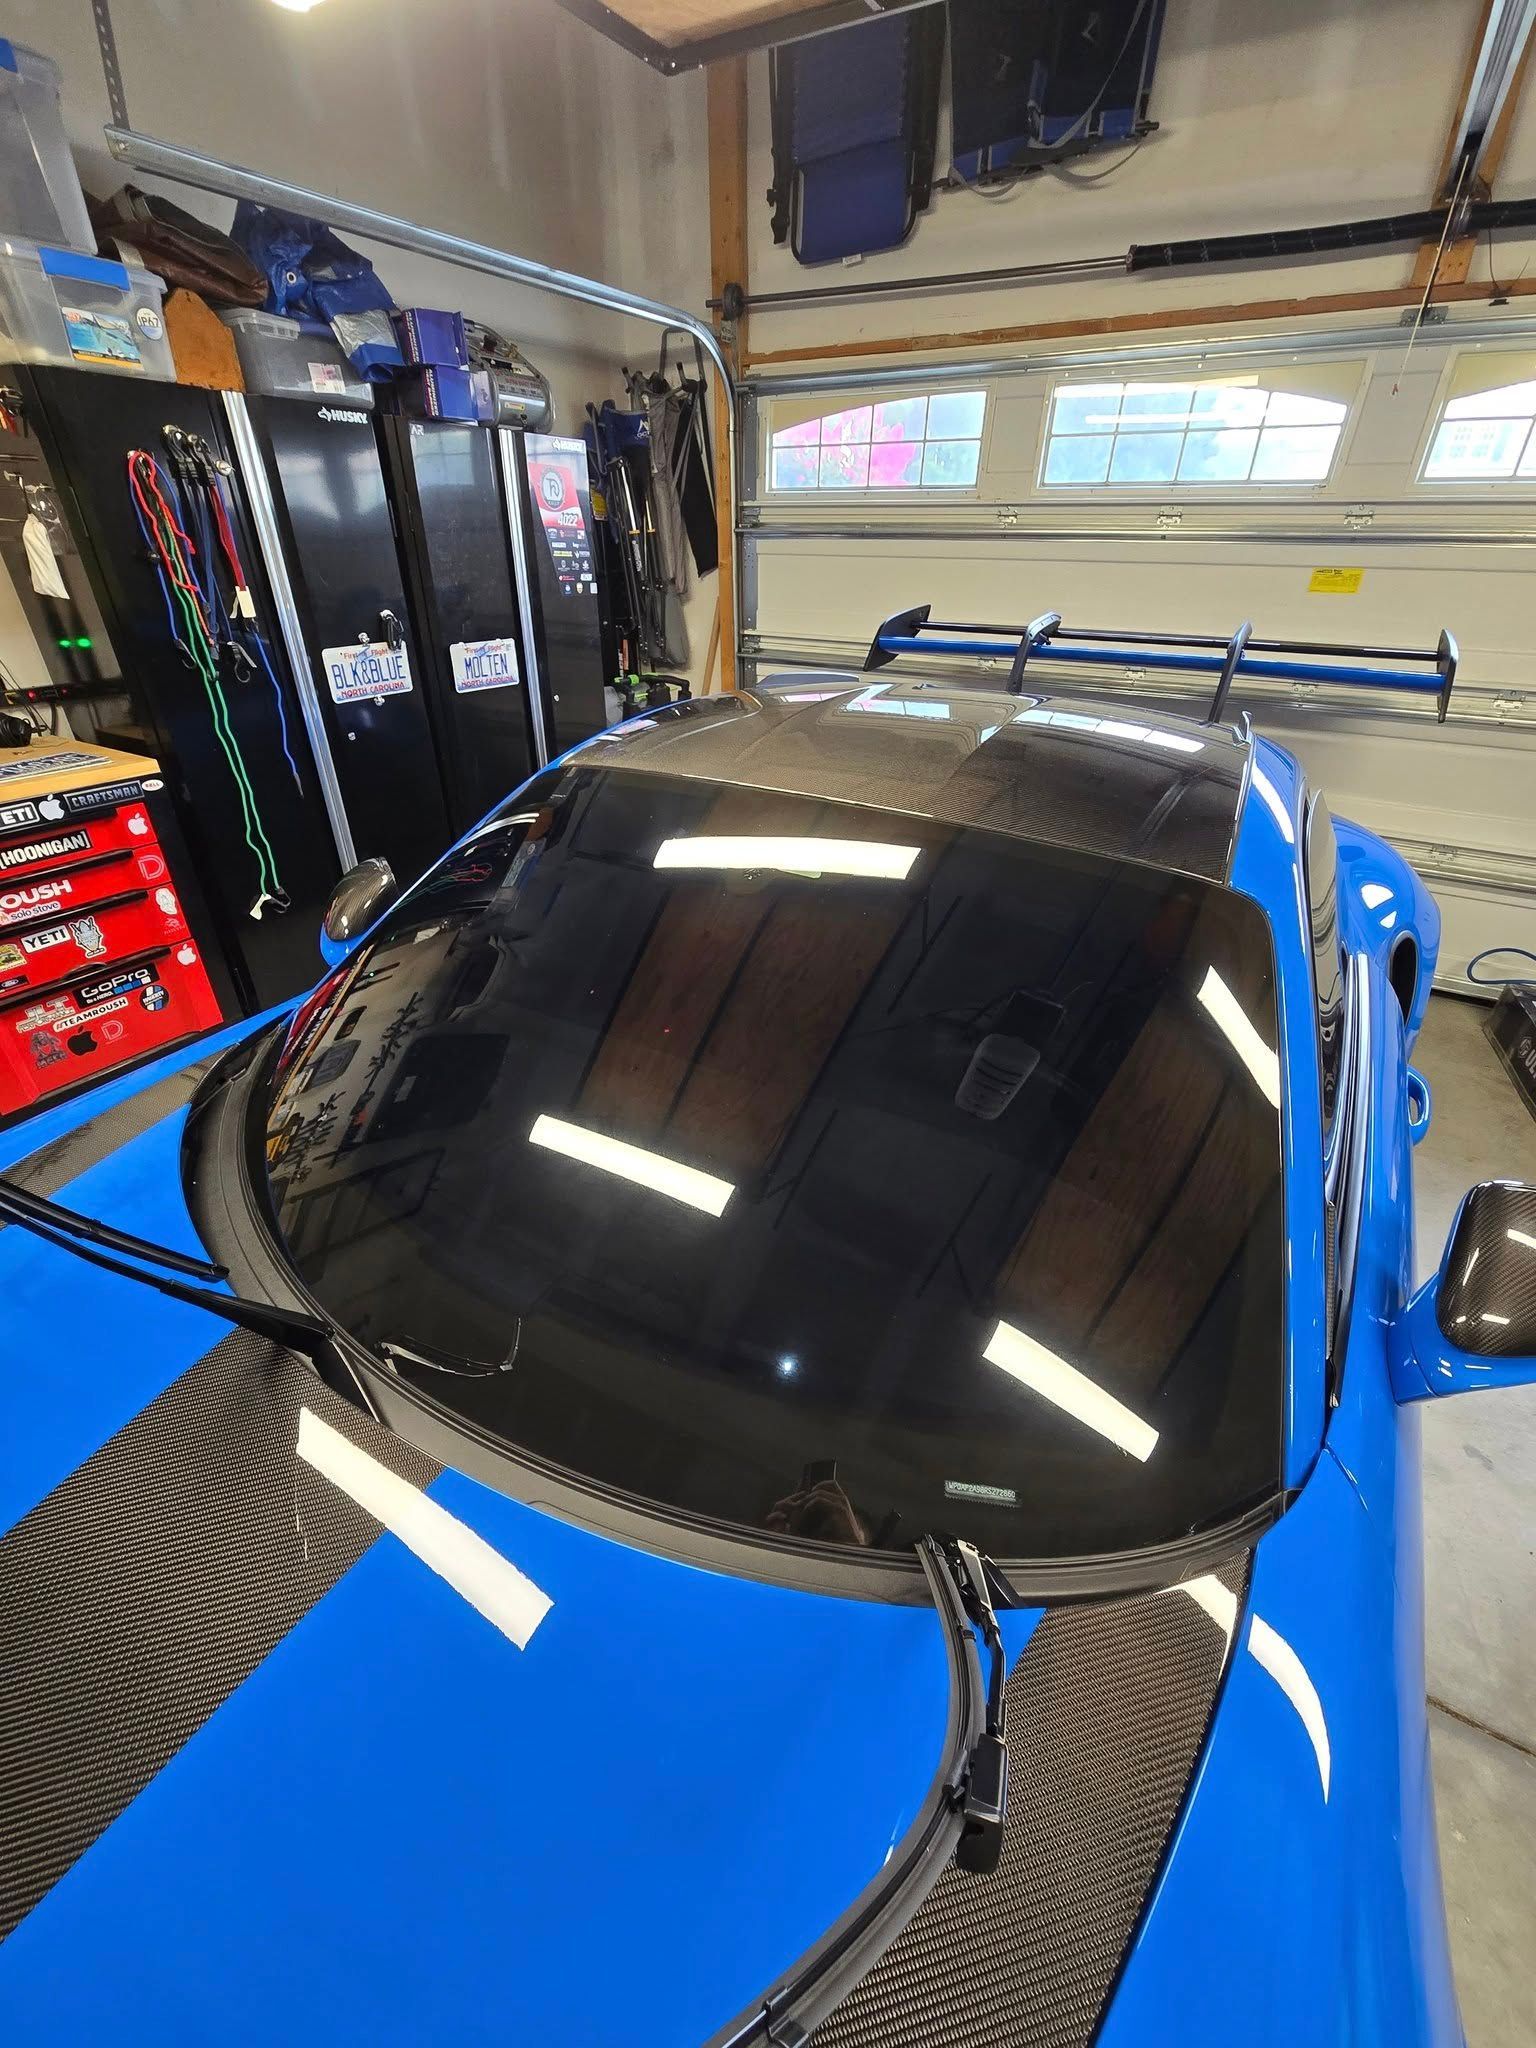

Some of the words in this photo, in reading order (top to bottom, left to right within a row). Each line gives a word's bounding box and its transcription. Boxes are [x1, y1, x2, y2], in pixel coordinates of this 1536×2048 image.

[330, 409, 368, 424] HUSKY
[331, 656, 406, 689] BLK&BLUE
[464, 653, 508, 679] MOLTEN
[341, 688, 368, 698] NORTH
[370, 681, 405, 693] CAROLINA
[72, 785, 140, 807] CRAFTSMAN
[0, 806, 34, 825] ETI
[0, 879, 73, 909] OUSH
[10, 909, 32, 920] solo
[33, 902, 59, 914] stove
[25, 929, 67, 949] YETI
[81, 968, 150, 998] GoPro
